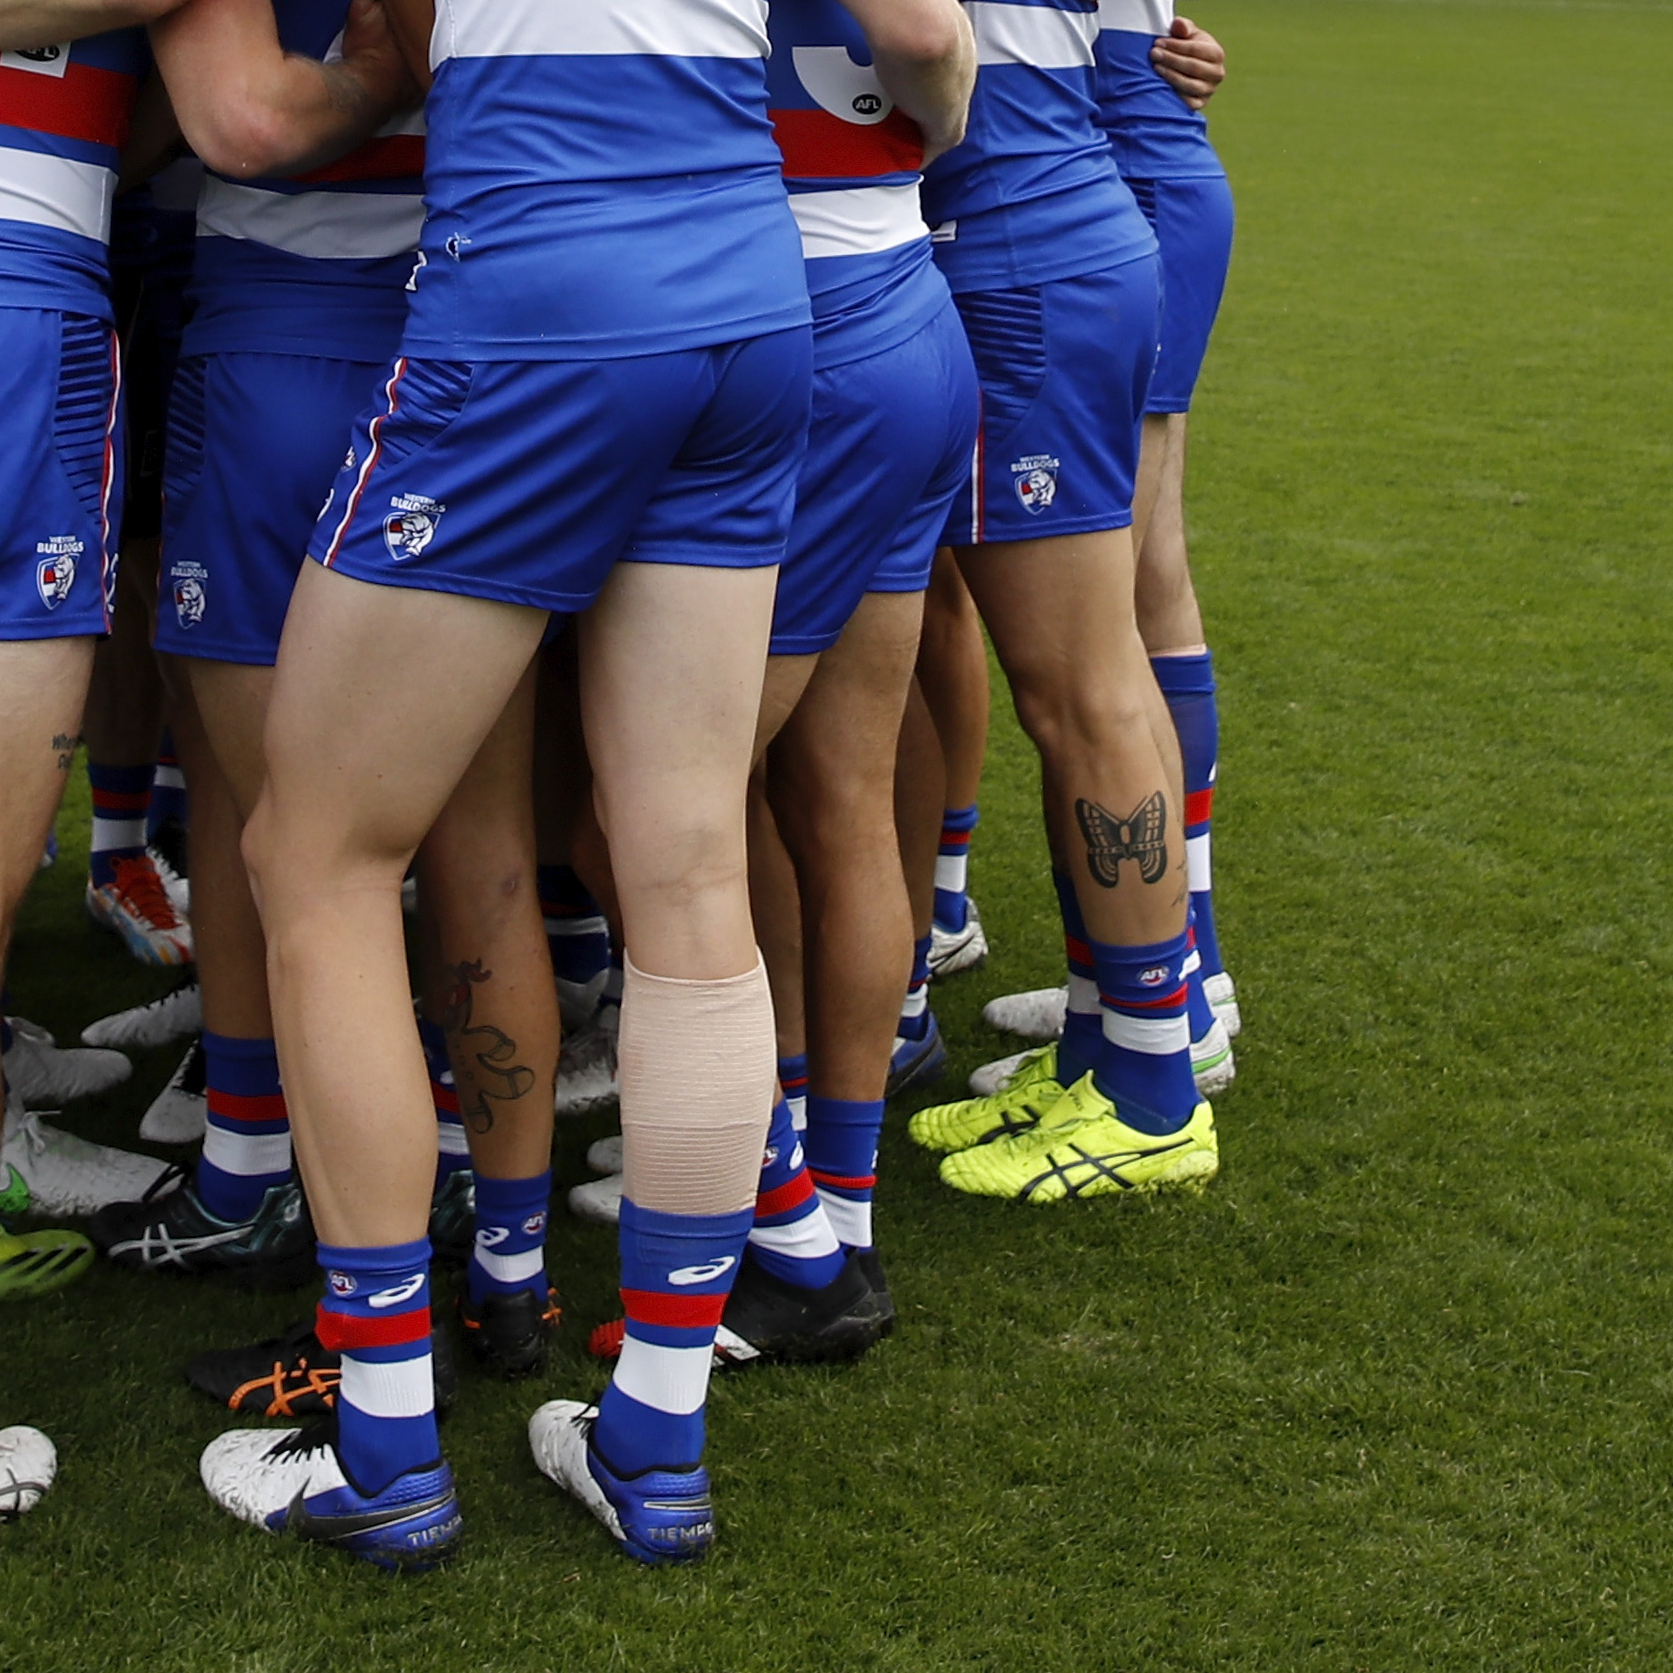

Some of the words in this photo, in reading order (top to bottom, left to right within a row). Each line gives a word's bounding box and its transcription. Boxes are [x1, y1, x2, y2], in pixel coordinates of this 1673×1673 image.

[855, 99, 880, 110] AFL
[390, 496, 447, 513] BULLDOGS
[36, 541, 84, 554] BULLDOGS
[1140, 968, 1166, 980] AFL
